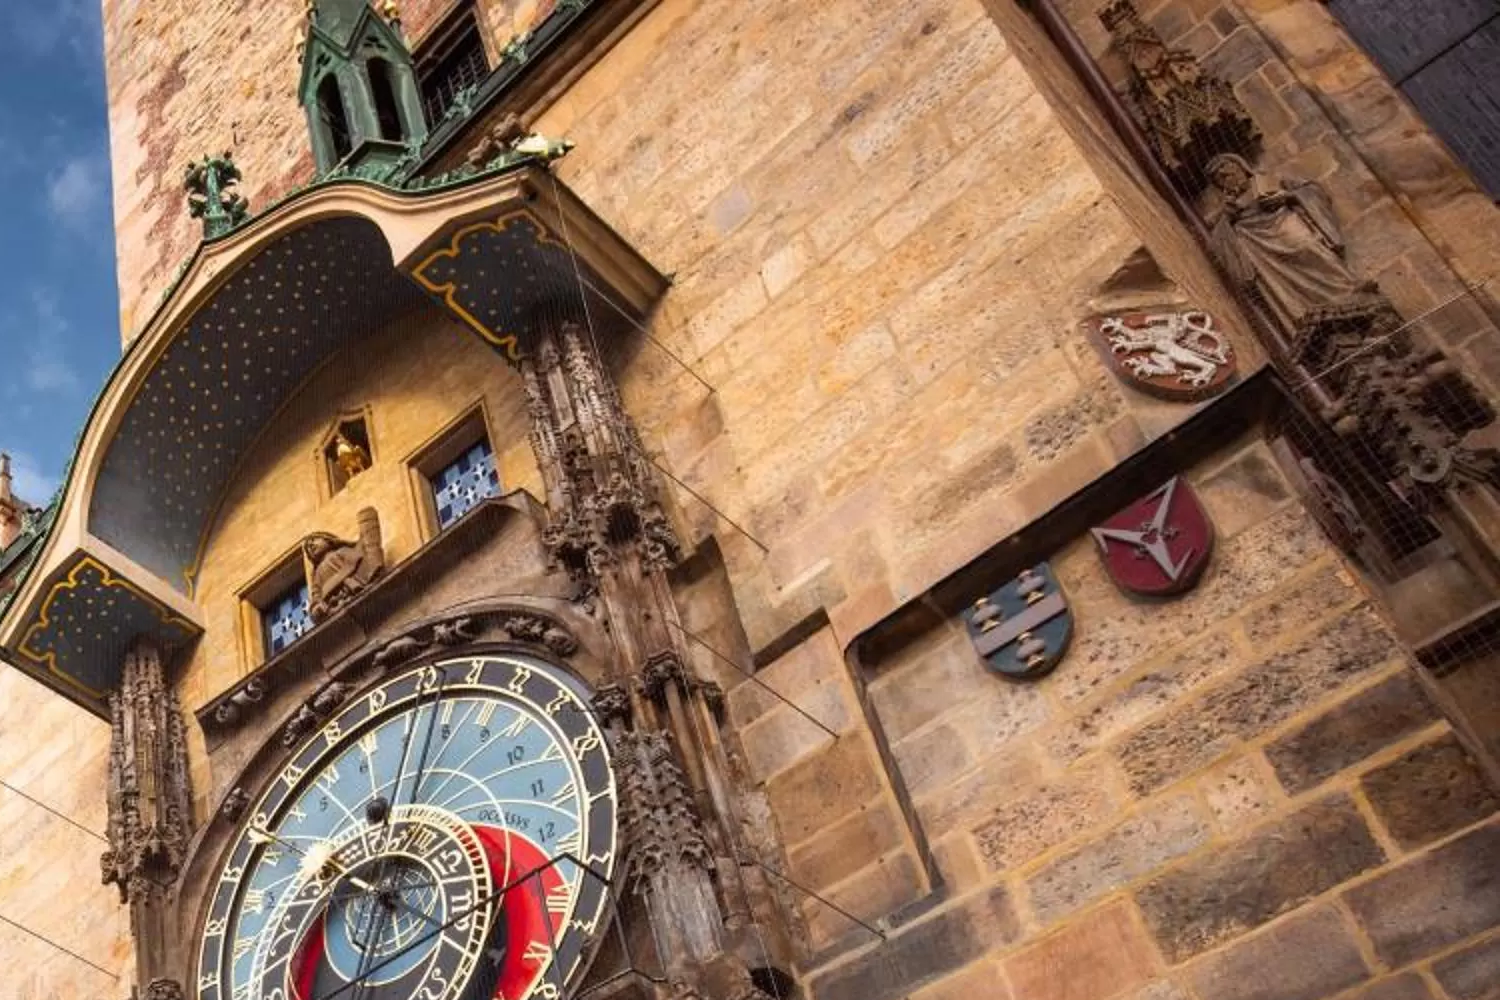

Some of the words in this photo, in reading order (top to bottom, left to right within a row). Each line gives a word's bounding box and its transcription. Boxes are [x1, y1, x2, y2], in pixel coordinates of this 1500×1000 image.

[507, 745, 525, 766] 10
[530, 778, 545, 798] 11
[537, 820, 556, 844] 12
